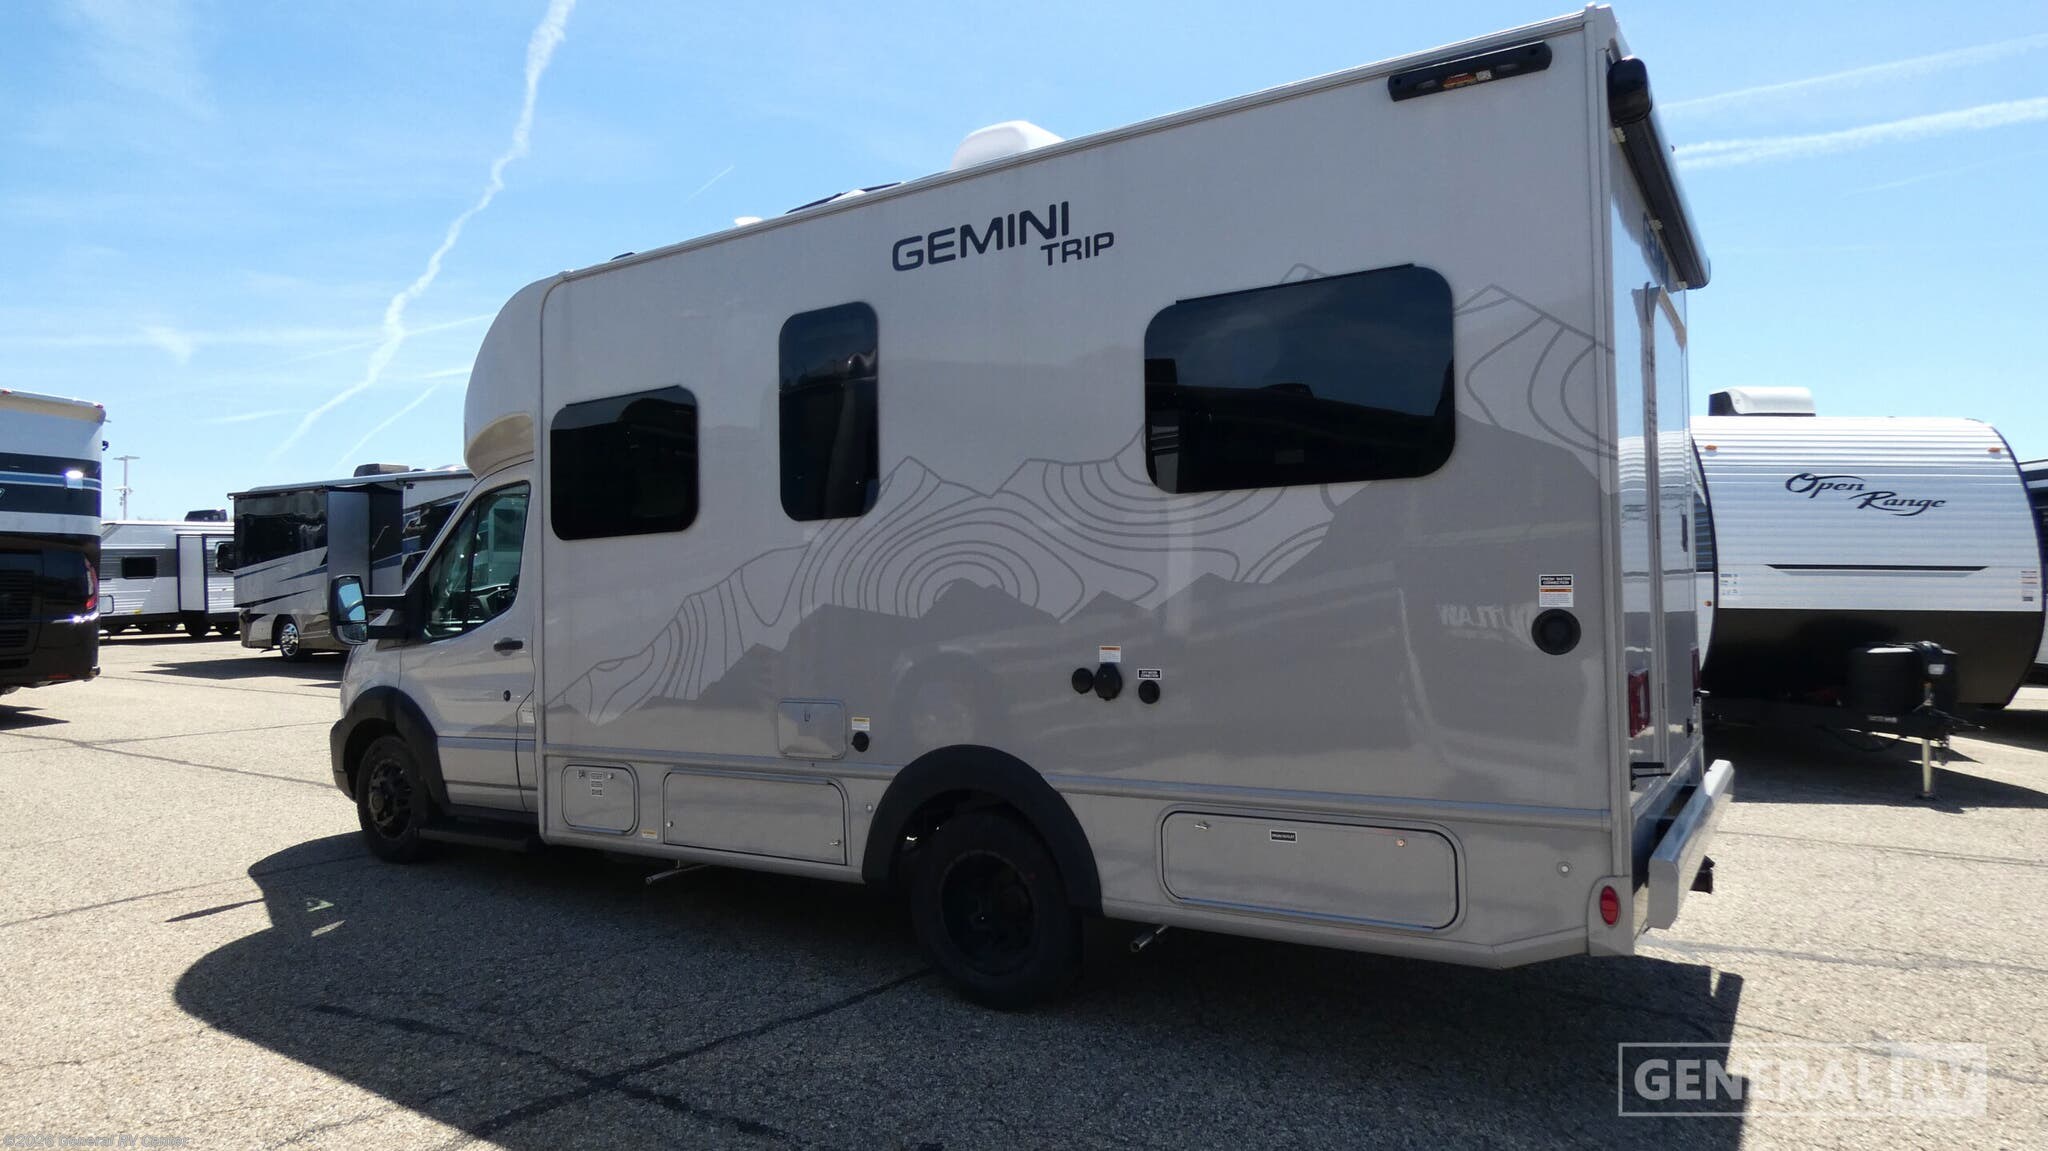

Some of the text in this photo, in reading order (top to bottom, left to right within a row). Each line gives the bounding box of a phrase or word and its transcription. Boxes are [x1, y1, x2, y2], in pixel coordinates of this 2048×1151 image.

[892, 201, 1069, 271] GEMINI
[1040, 231, 1114, 266] TRIP
[1785, 472, 1866, 499] Open
[1848, 491, 1947, 516] Range
